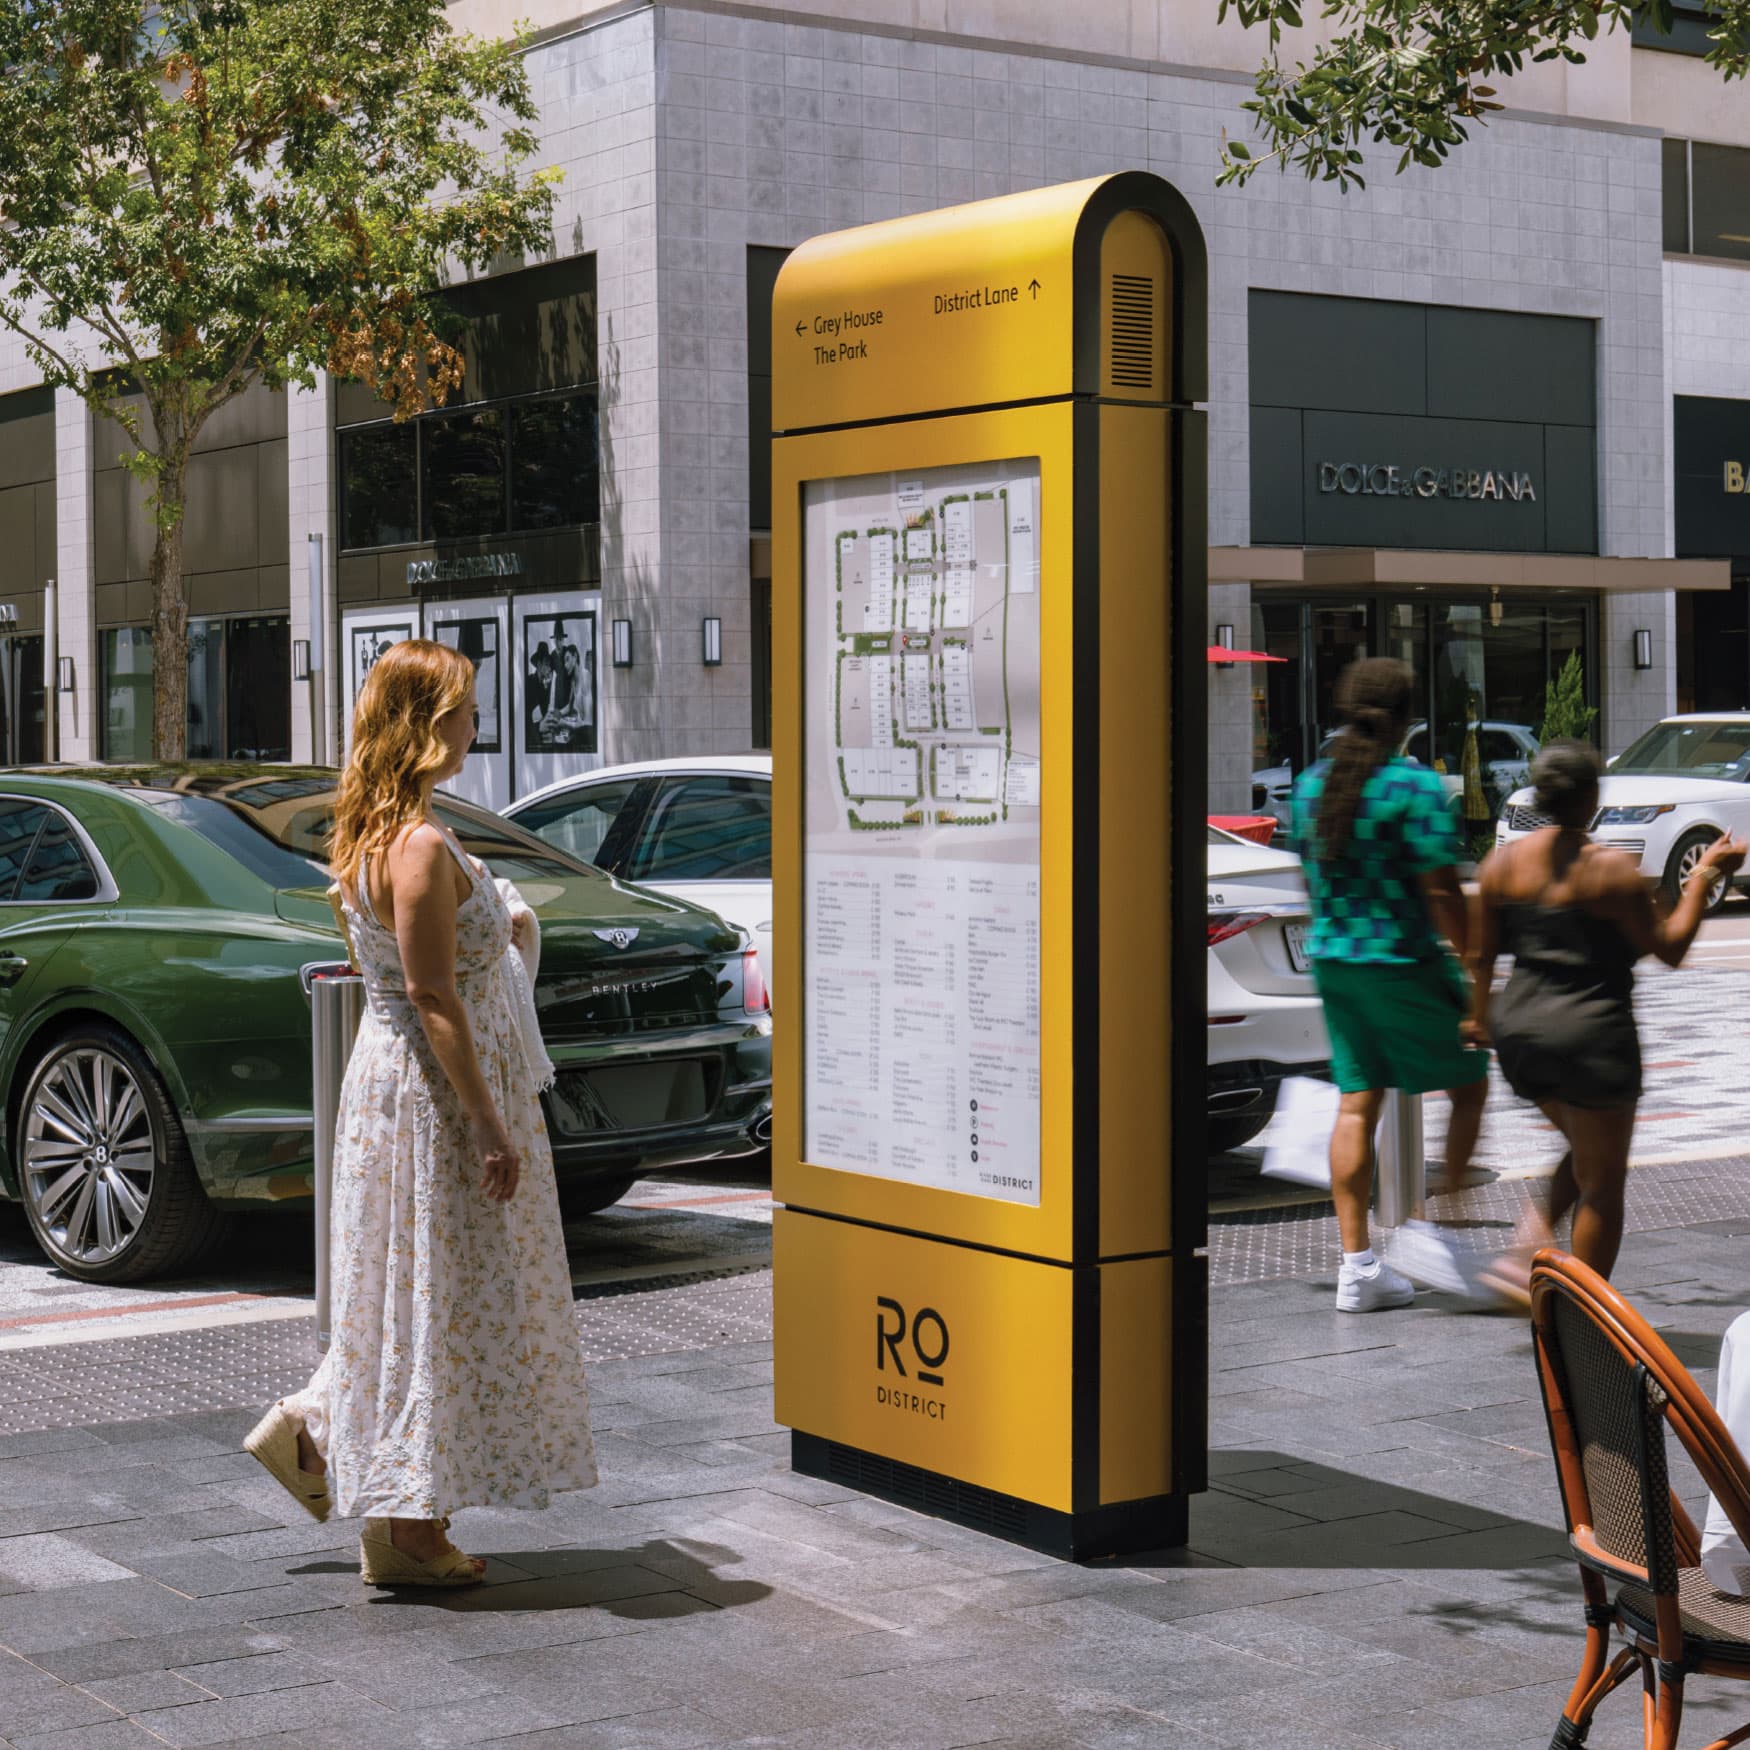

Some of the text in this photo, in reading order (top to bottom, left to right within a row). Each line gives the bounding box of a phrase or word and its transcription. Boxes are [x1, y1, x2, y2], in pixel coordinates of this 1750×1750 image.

[934, 287, 1018, 314] District Lane
[813, 309, 883, 337] Grey House
[814, 340, 867, 365] The Park
[592, 983, 657, 994] BENTLEY
[992, 1175, 1033, 1191] DISTRICT
[877, 1295, 950, 1387] RO
[877, 1386, 946, 1421] DISTRICT
